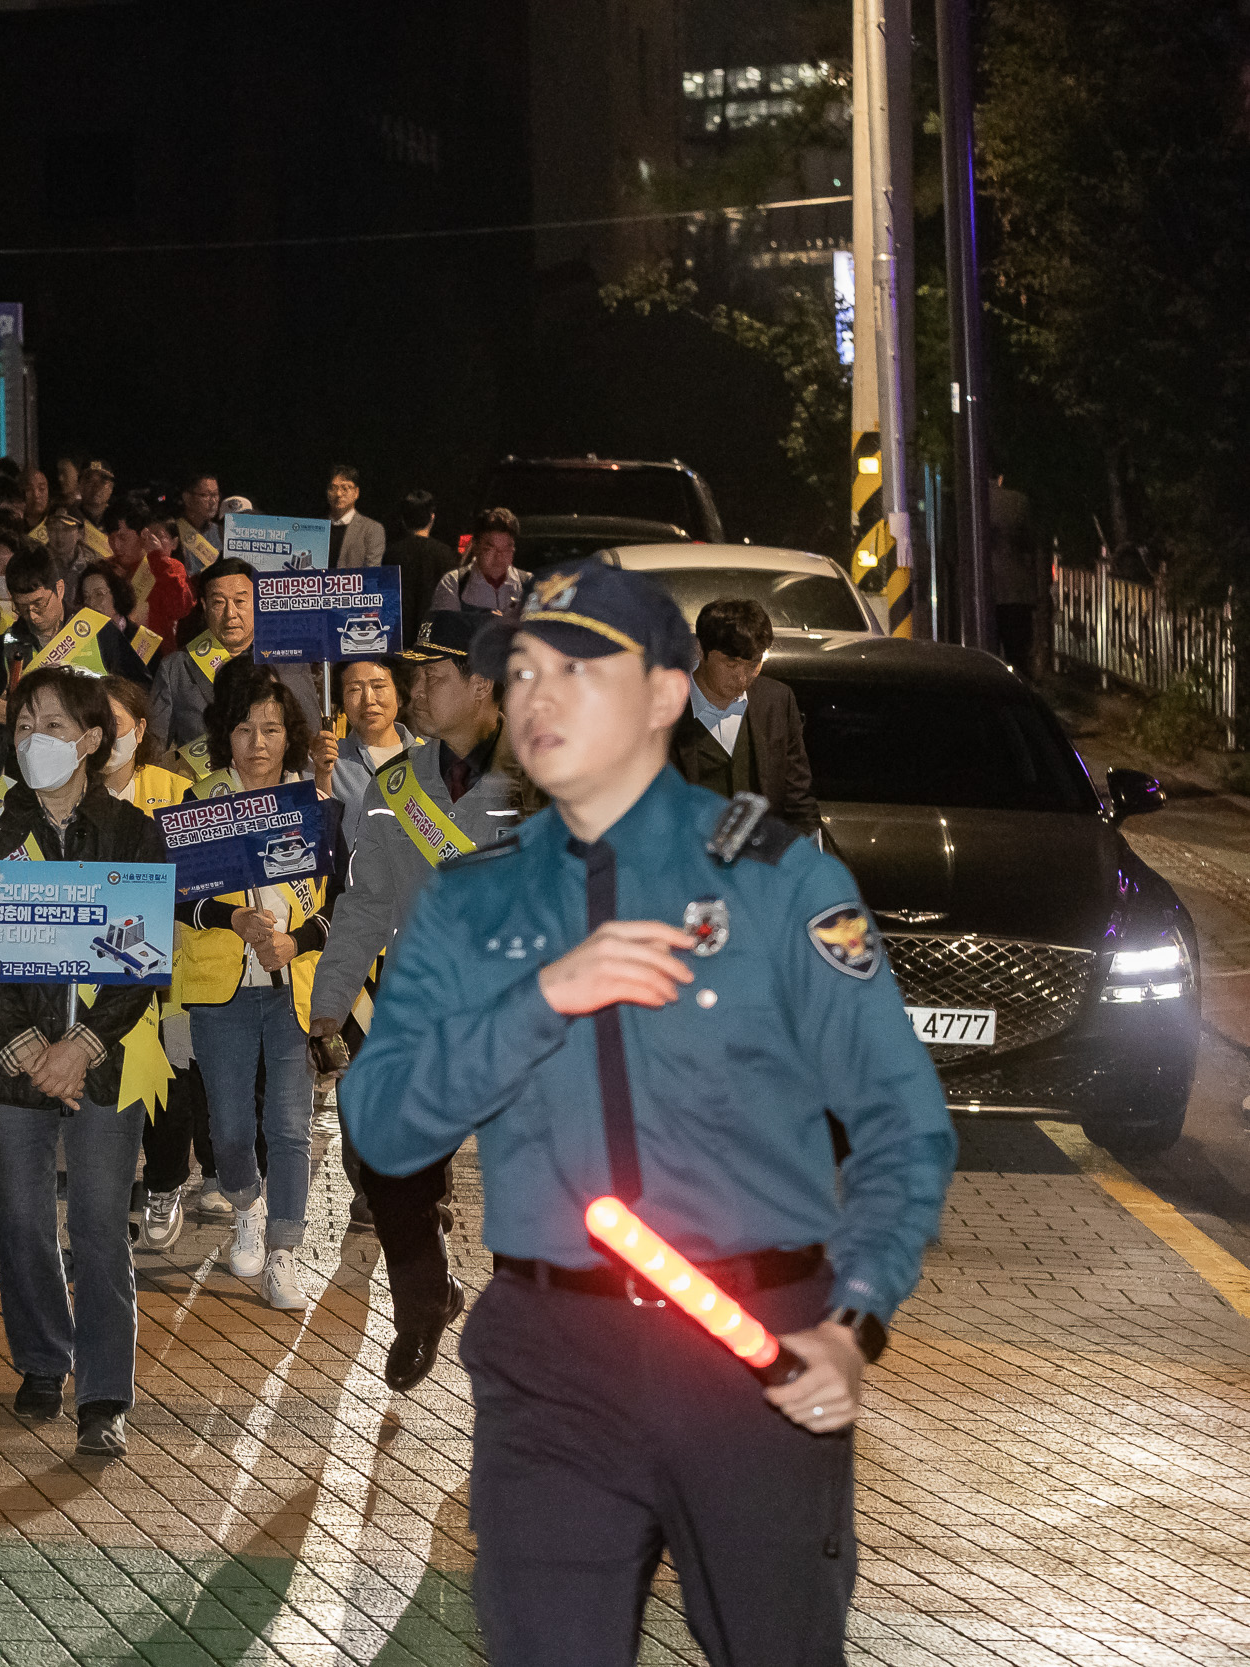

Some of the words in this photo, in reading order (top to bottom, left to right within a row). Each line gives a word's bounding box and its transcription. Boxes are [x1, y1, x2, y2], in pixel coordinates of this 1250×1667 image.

[258, 576, 323, 598] 건대맛의
[324, 573, 363, 595] 거리!
[259, 597, 289, 612] 청춘에
[290, 596, 321, 611] 안전과
[322, 595, 351, 609] 품격을
[352, 593, 383, 608] 더하다
[160, 802, 234, 834] 건대맛의
[235, 793, 277, 819] 거리!
[403, 795, 445, 849] 범죄없는
[166, 830, 200, 848] 청춘에
[201, 824, 235, 843] 안전과
[235, 817, 268, 836] 품격을
[268, 811, 303, 829] 더하다
[122, 873, 167, 881] 서울광진경찰서
[34, 905, 75, 923] 안전과
[77, 906, 104, 924] 품격
[1, 961, 58, 977] 긴급신고는
[59, 960, 90, 976] 112
[922, 1013, 990, 1041] 4777
